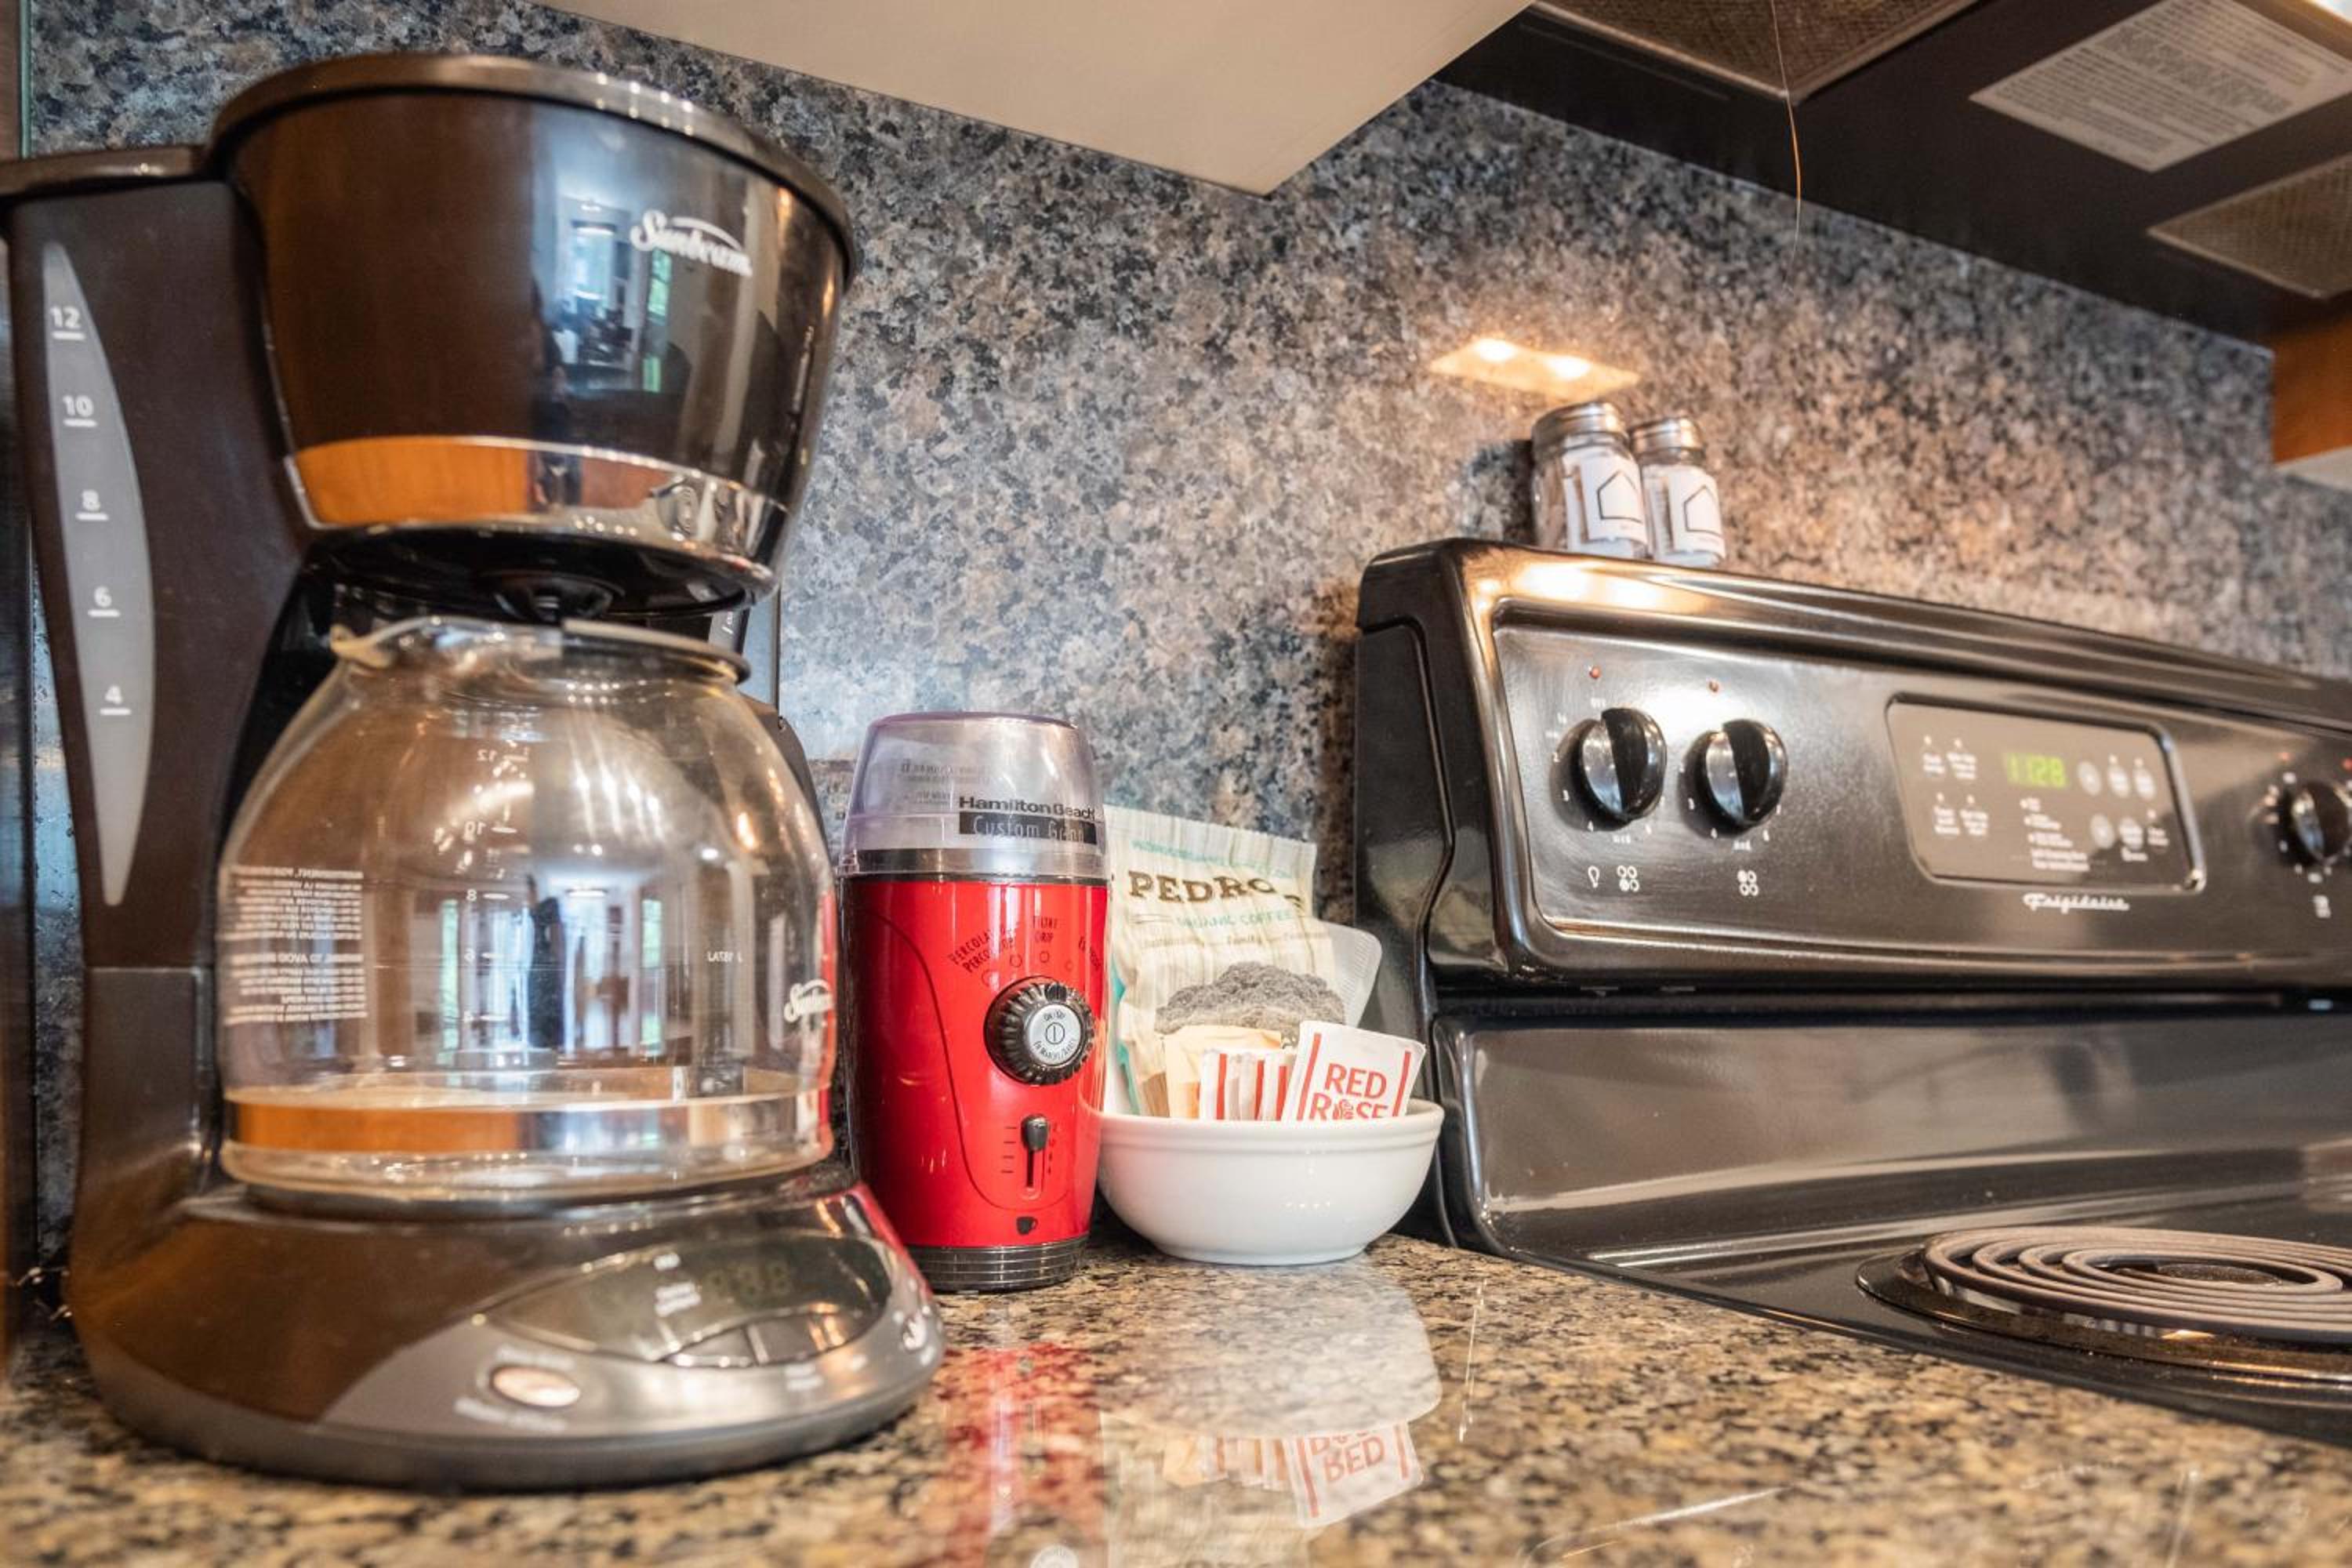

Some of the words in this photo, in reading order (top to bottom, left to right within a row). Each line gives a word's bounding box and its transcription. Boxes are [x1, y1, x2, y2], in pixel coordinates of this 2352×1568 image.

[51, 307, 79, 327] 12
[64, 396, 93, 416] 10
[82, 490, 100, 510] 8
[94, 586, 111, 607] 6
[106, 685, 122, 704] 4
[960, 796, 1051, 814] Hamilton
[1325, 1063, 1387, 1099] RED
